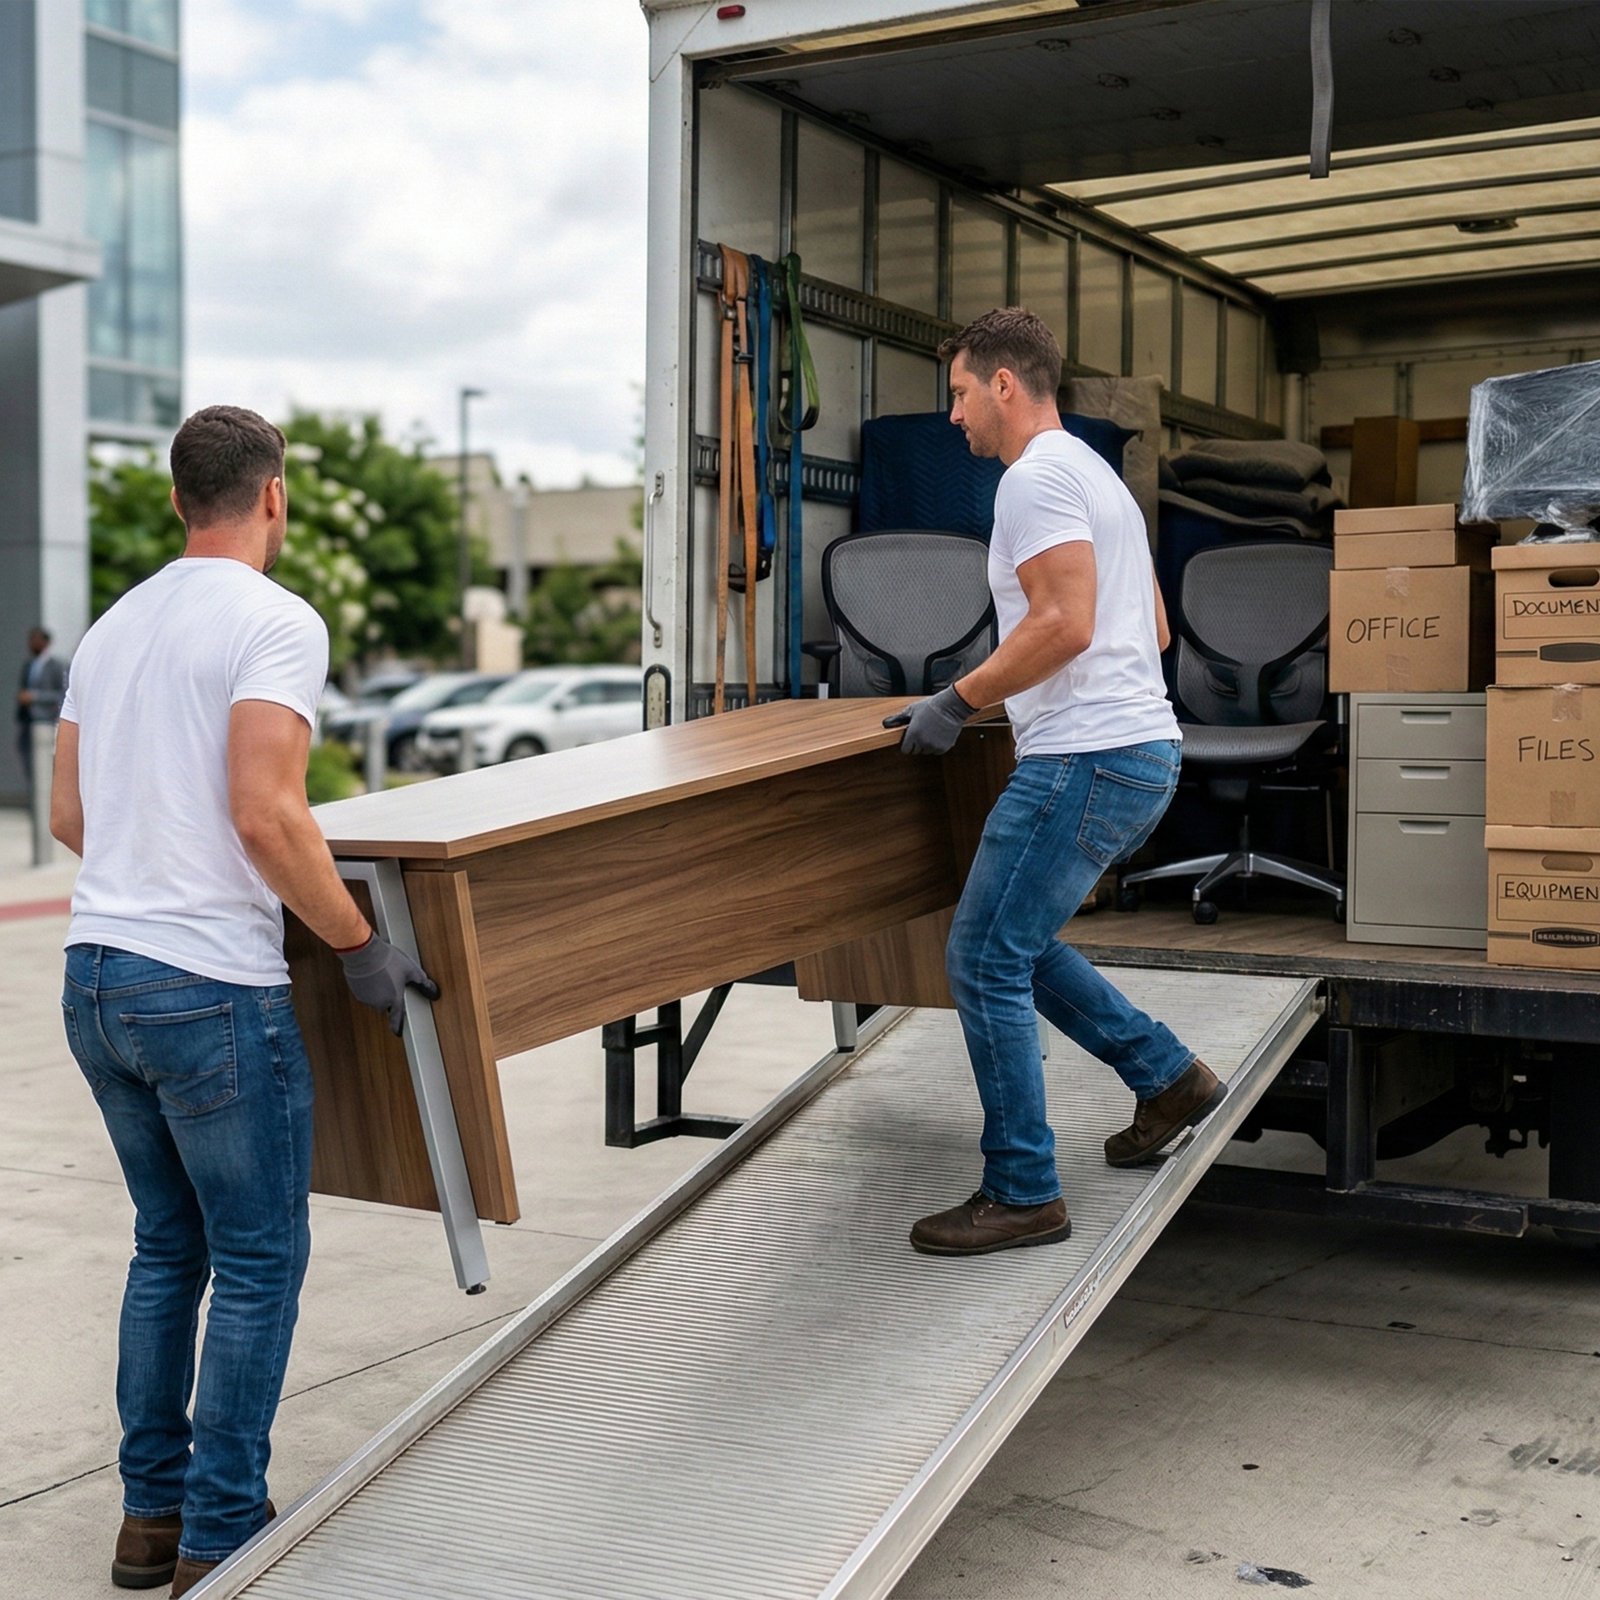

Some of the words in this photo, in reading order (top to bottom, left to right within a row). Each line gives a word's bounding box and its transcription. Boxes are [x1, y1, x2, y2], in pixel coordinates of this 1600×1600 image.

[1512, 599, 1600, 616] DOCUMEN
[1346, 615, 1441, 644] OFFICE
[1518, 735, 1595, 763] FILES
[1504, 881, 1600, 902] EQUIPMEN
